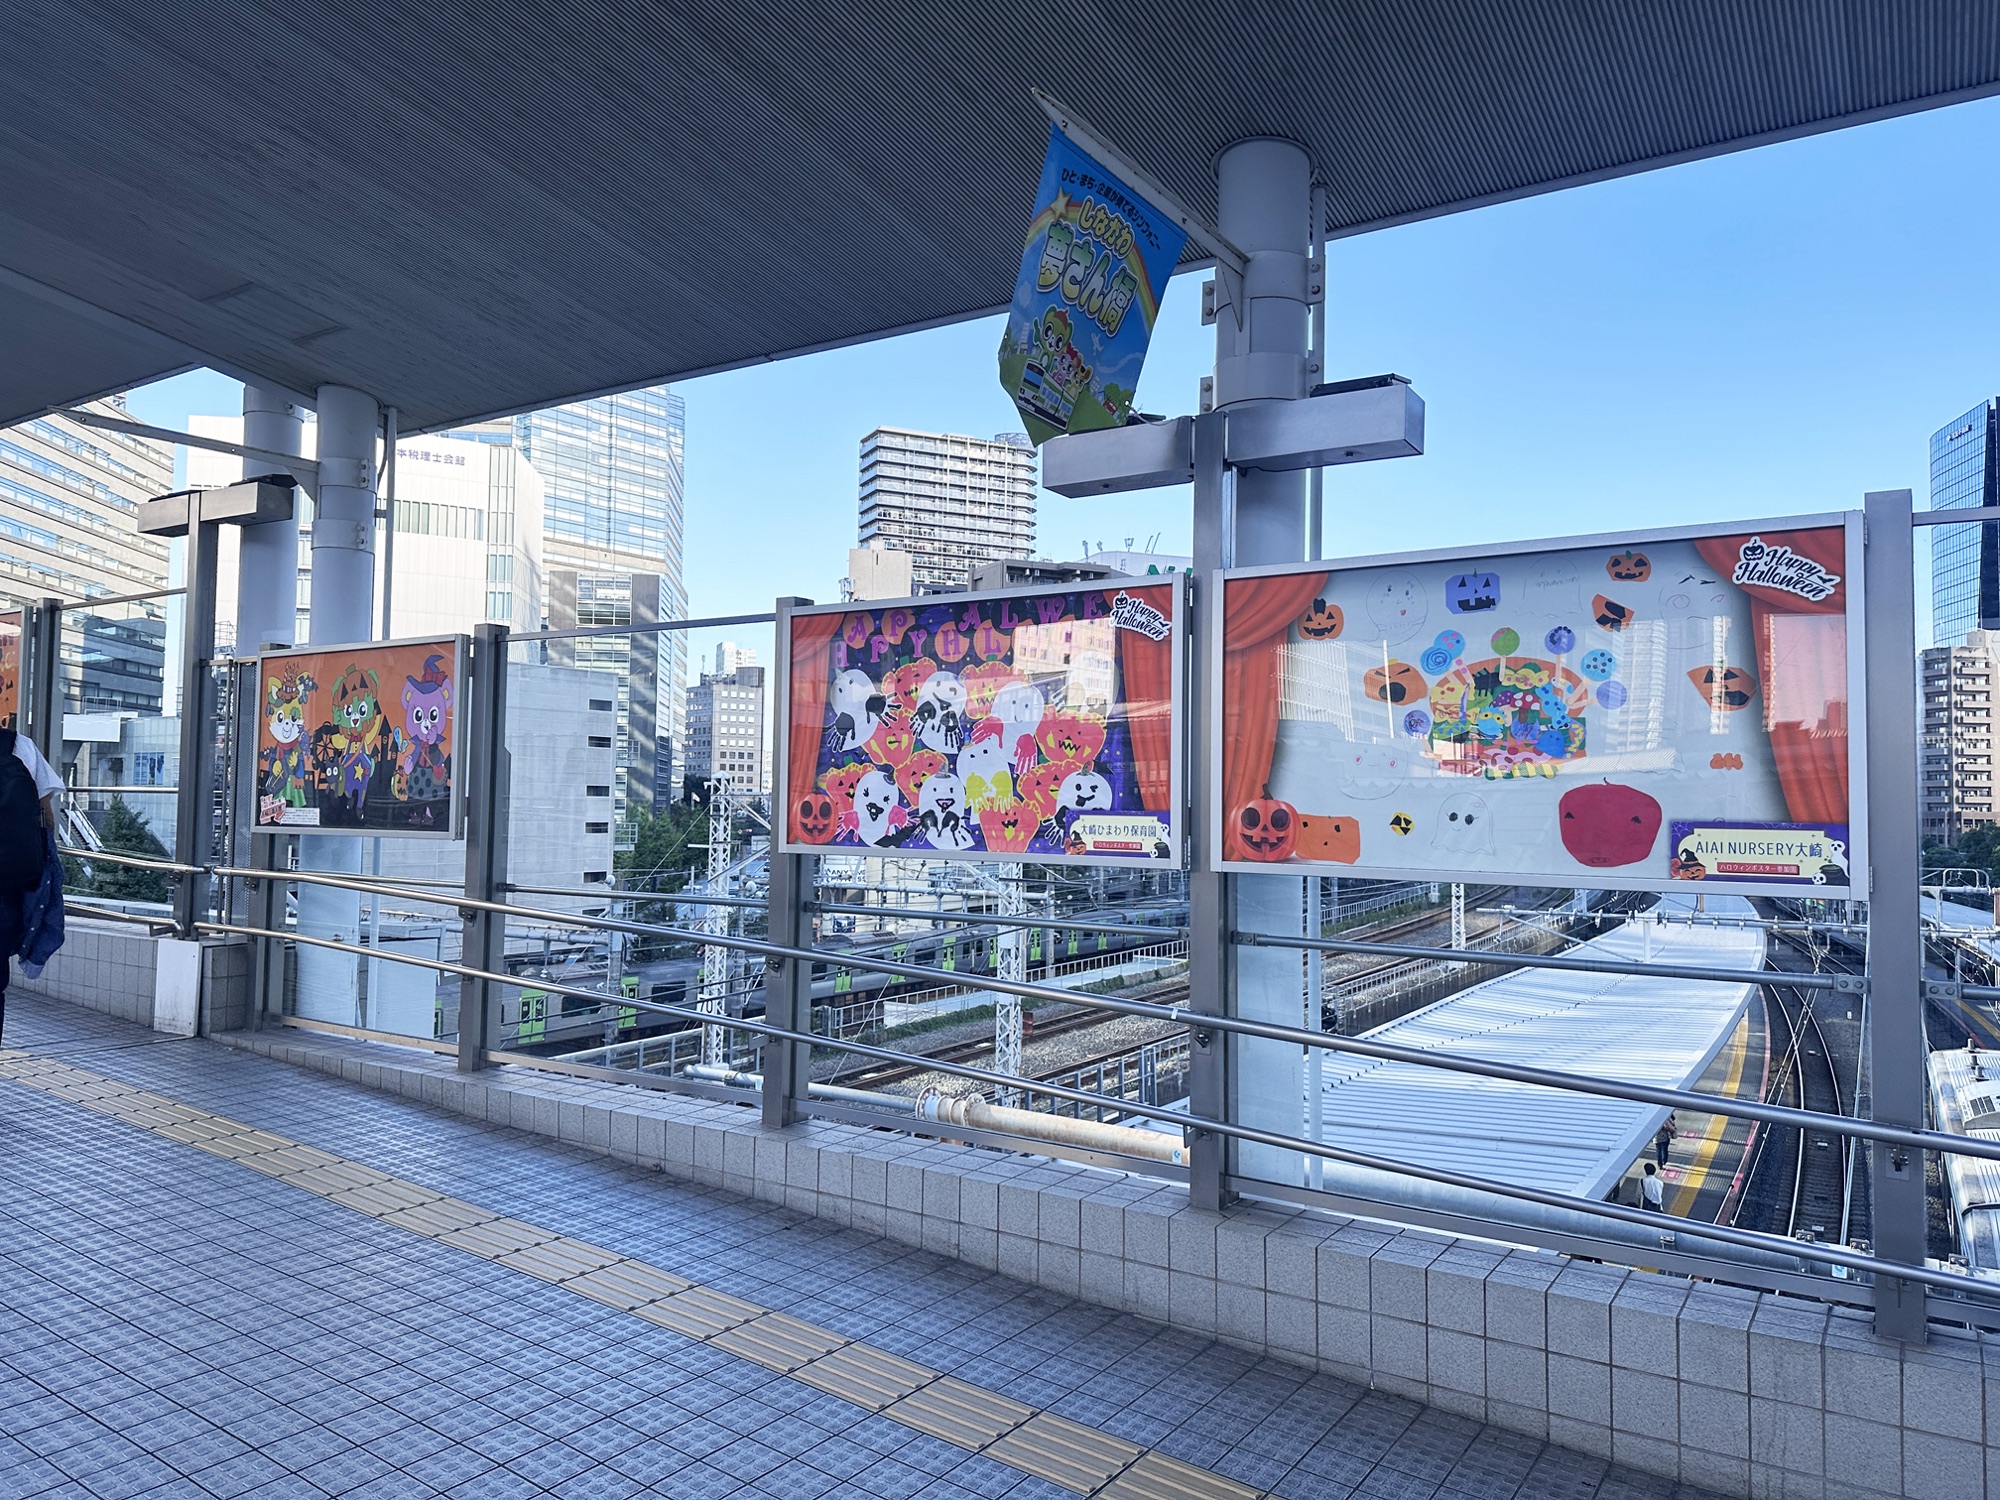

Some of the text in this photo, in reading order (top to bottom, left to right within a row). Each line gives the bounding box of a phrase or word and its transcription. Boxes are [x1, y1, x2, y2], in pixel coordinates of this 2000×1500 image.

[1079, 198, 1134, 257] しながわ
[1038, 221, 1138, 334] 夢さん橋
[1764, 548, 1822, 579] Happy
[1735, 561, 1827, 598] Halloween
[1111, 610, 1165, 639] Halloween
[1127, 599, 1162, 625] Happy
[1080, 824, 1157, 837] 大崎ひまわり保育園
[1695, 841, 1723, 854] AIAI
[1719, 864, 1798, 874] ハロウィンポスター参加園
